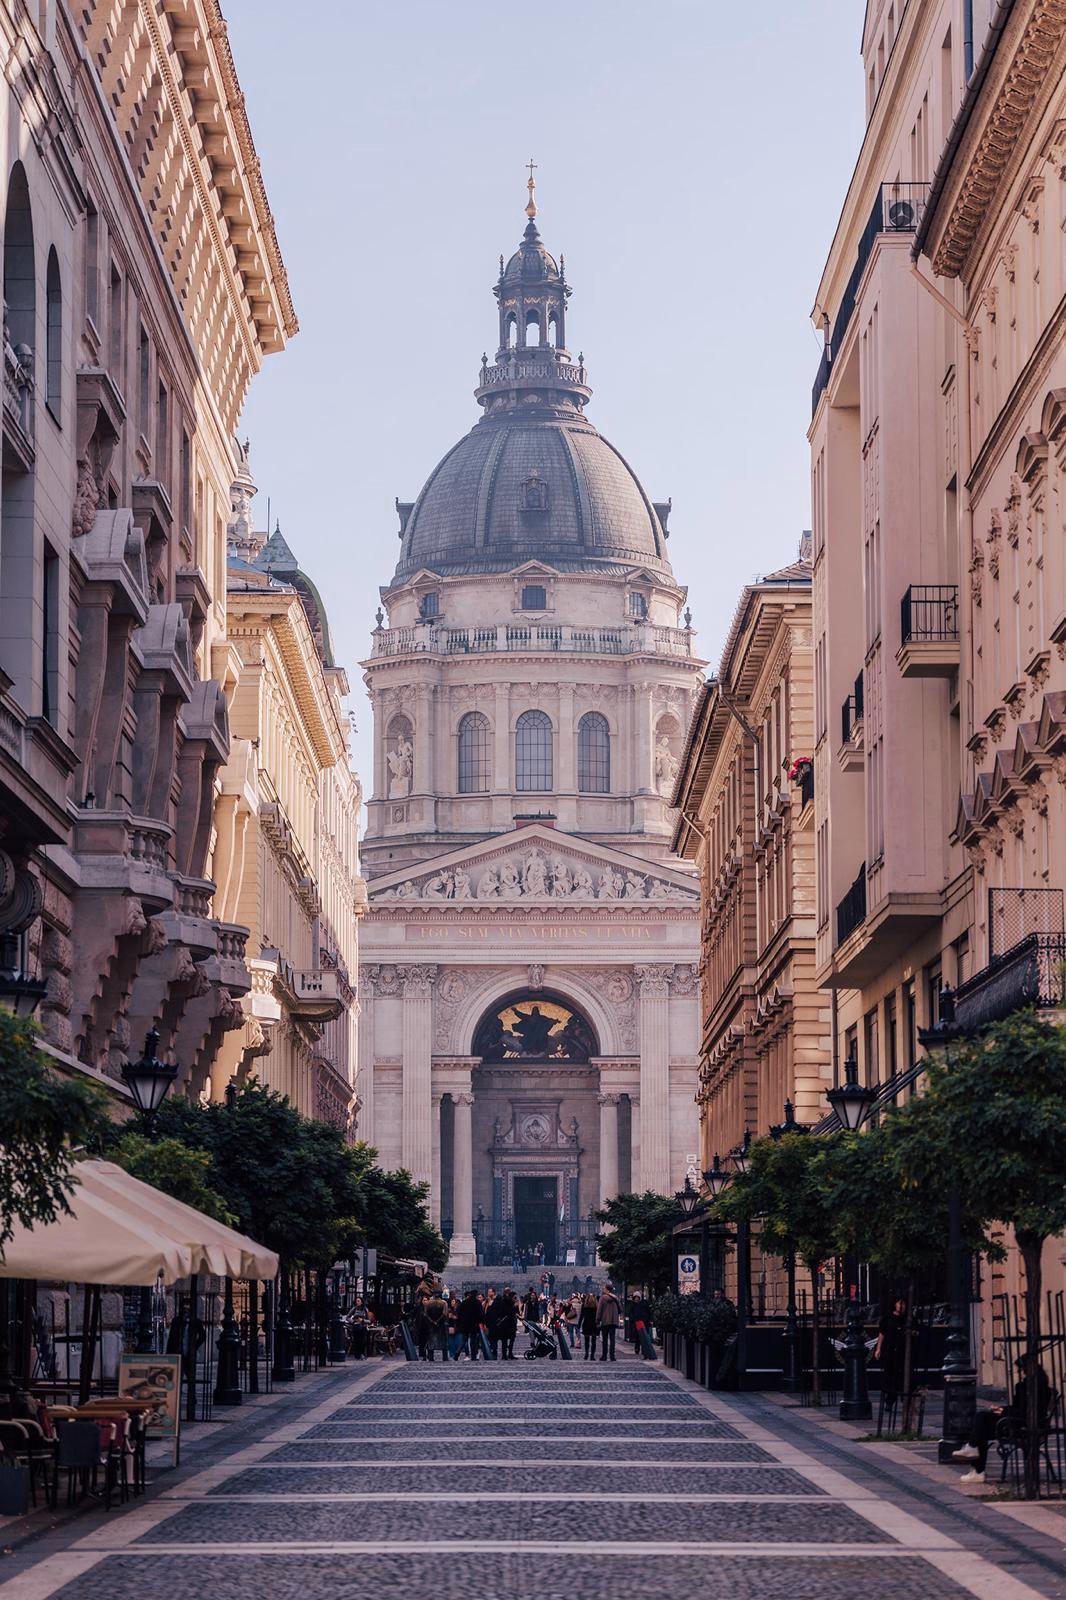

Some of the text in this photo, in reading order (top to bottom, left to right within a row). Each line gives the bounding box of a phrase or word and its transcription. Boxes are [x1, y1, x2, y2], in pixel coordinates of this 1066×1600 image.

[421, 927, 449, 938] EGO
[457, 927, 489, 938] SUM
[499, 927, 524, 938] VIA
[529, 927, 588, 938] VERITAS
[621, 927, 651, 938] VITA
